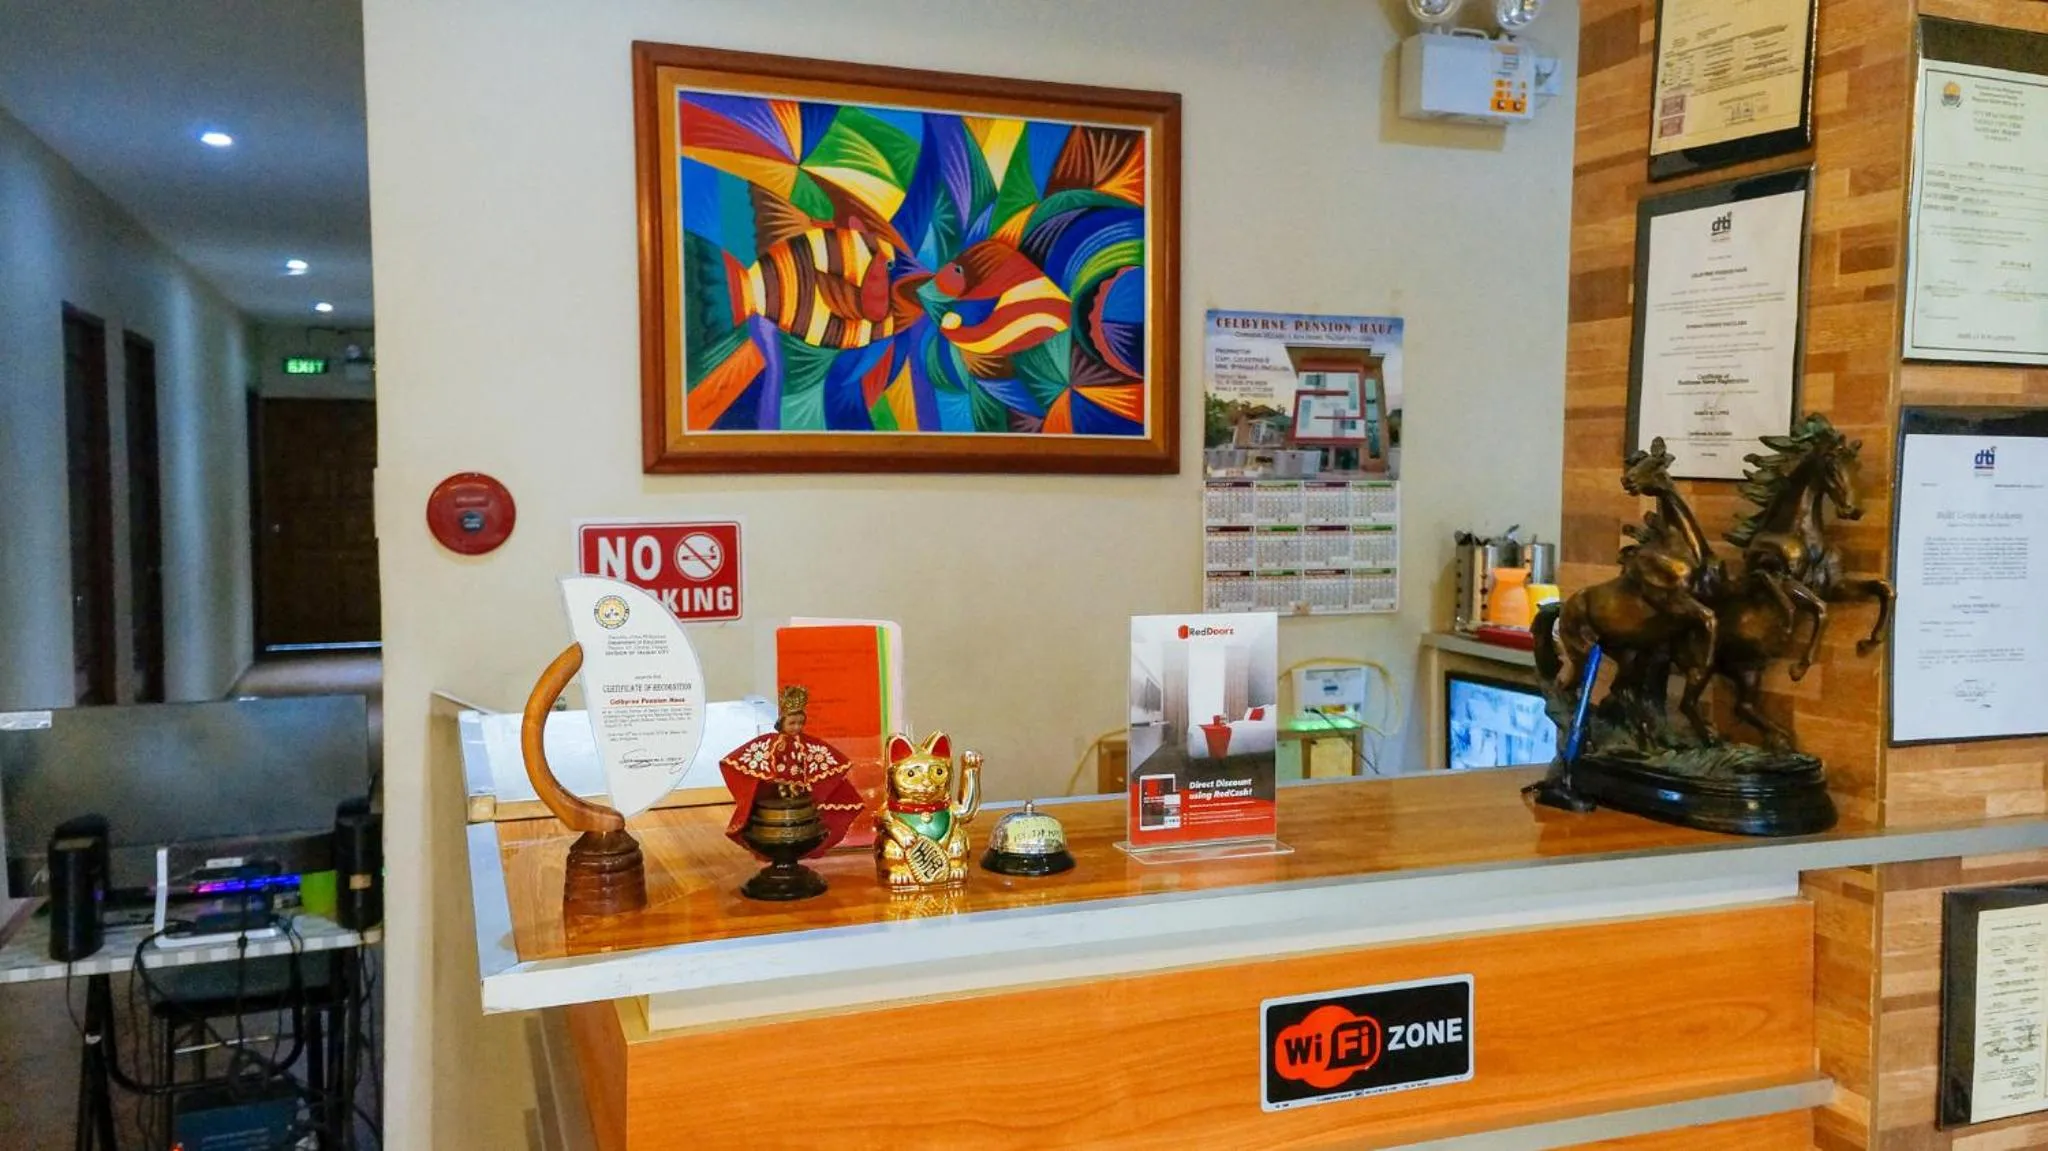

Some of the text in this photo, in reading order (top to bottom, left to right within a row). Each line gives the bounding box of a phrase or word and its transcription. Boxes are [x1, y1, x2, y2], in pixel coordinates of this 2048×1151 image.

[1294, 320, 1351, 333] PENSION
[288, 358, 324, 373] EXIT
[598, 535, 662, 581] NO
[647, 586, 733, 613] KING
[1189, 777, 1252, 790] Direct Discount
[1189, 791, 1213, 801] using
[1387, 1017, 1464, 1051] ZONE
